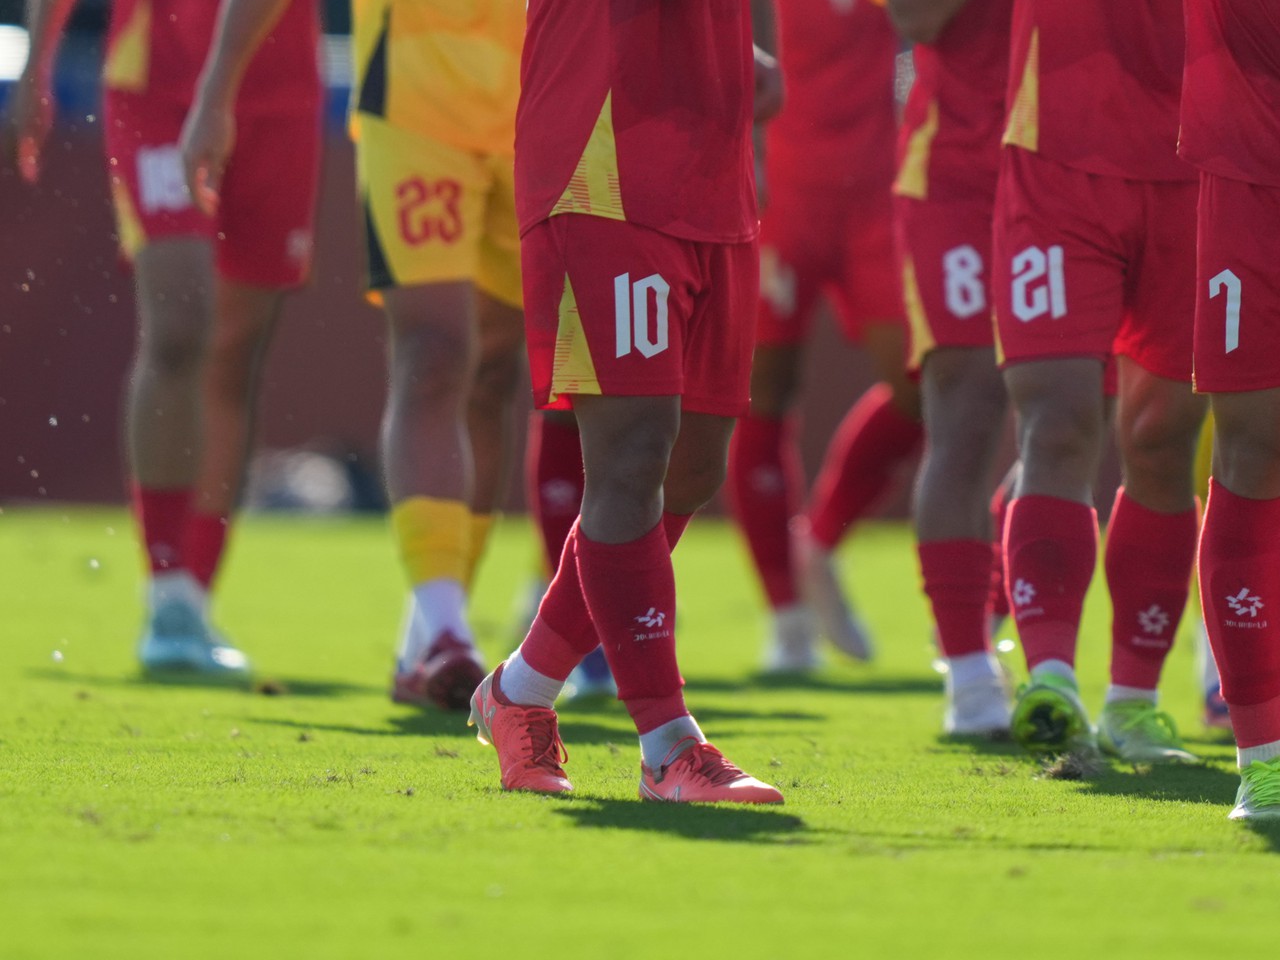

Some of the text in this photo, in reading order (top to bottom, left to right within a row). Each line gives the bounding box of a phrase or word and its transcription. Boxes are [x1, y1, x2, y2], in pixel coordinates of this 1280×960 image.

[396, 176, 462, 246] 23
[615, 272, 670, 358] 10
[943, 244, 985, 318] 8
[1012, 245, 1067, 322] 21
[1209, 269, 1241, 354] 7
